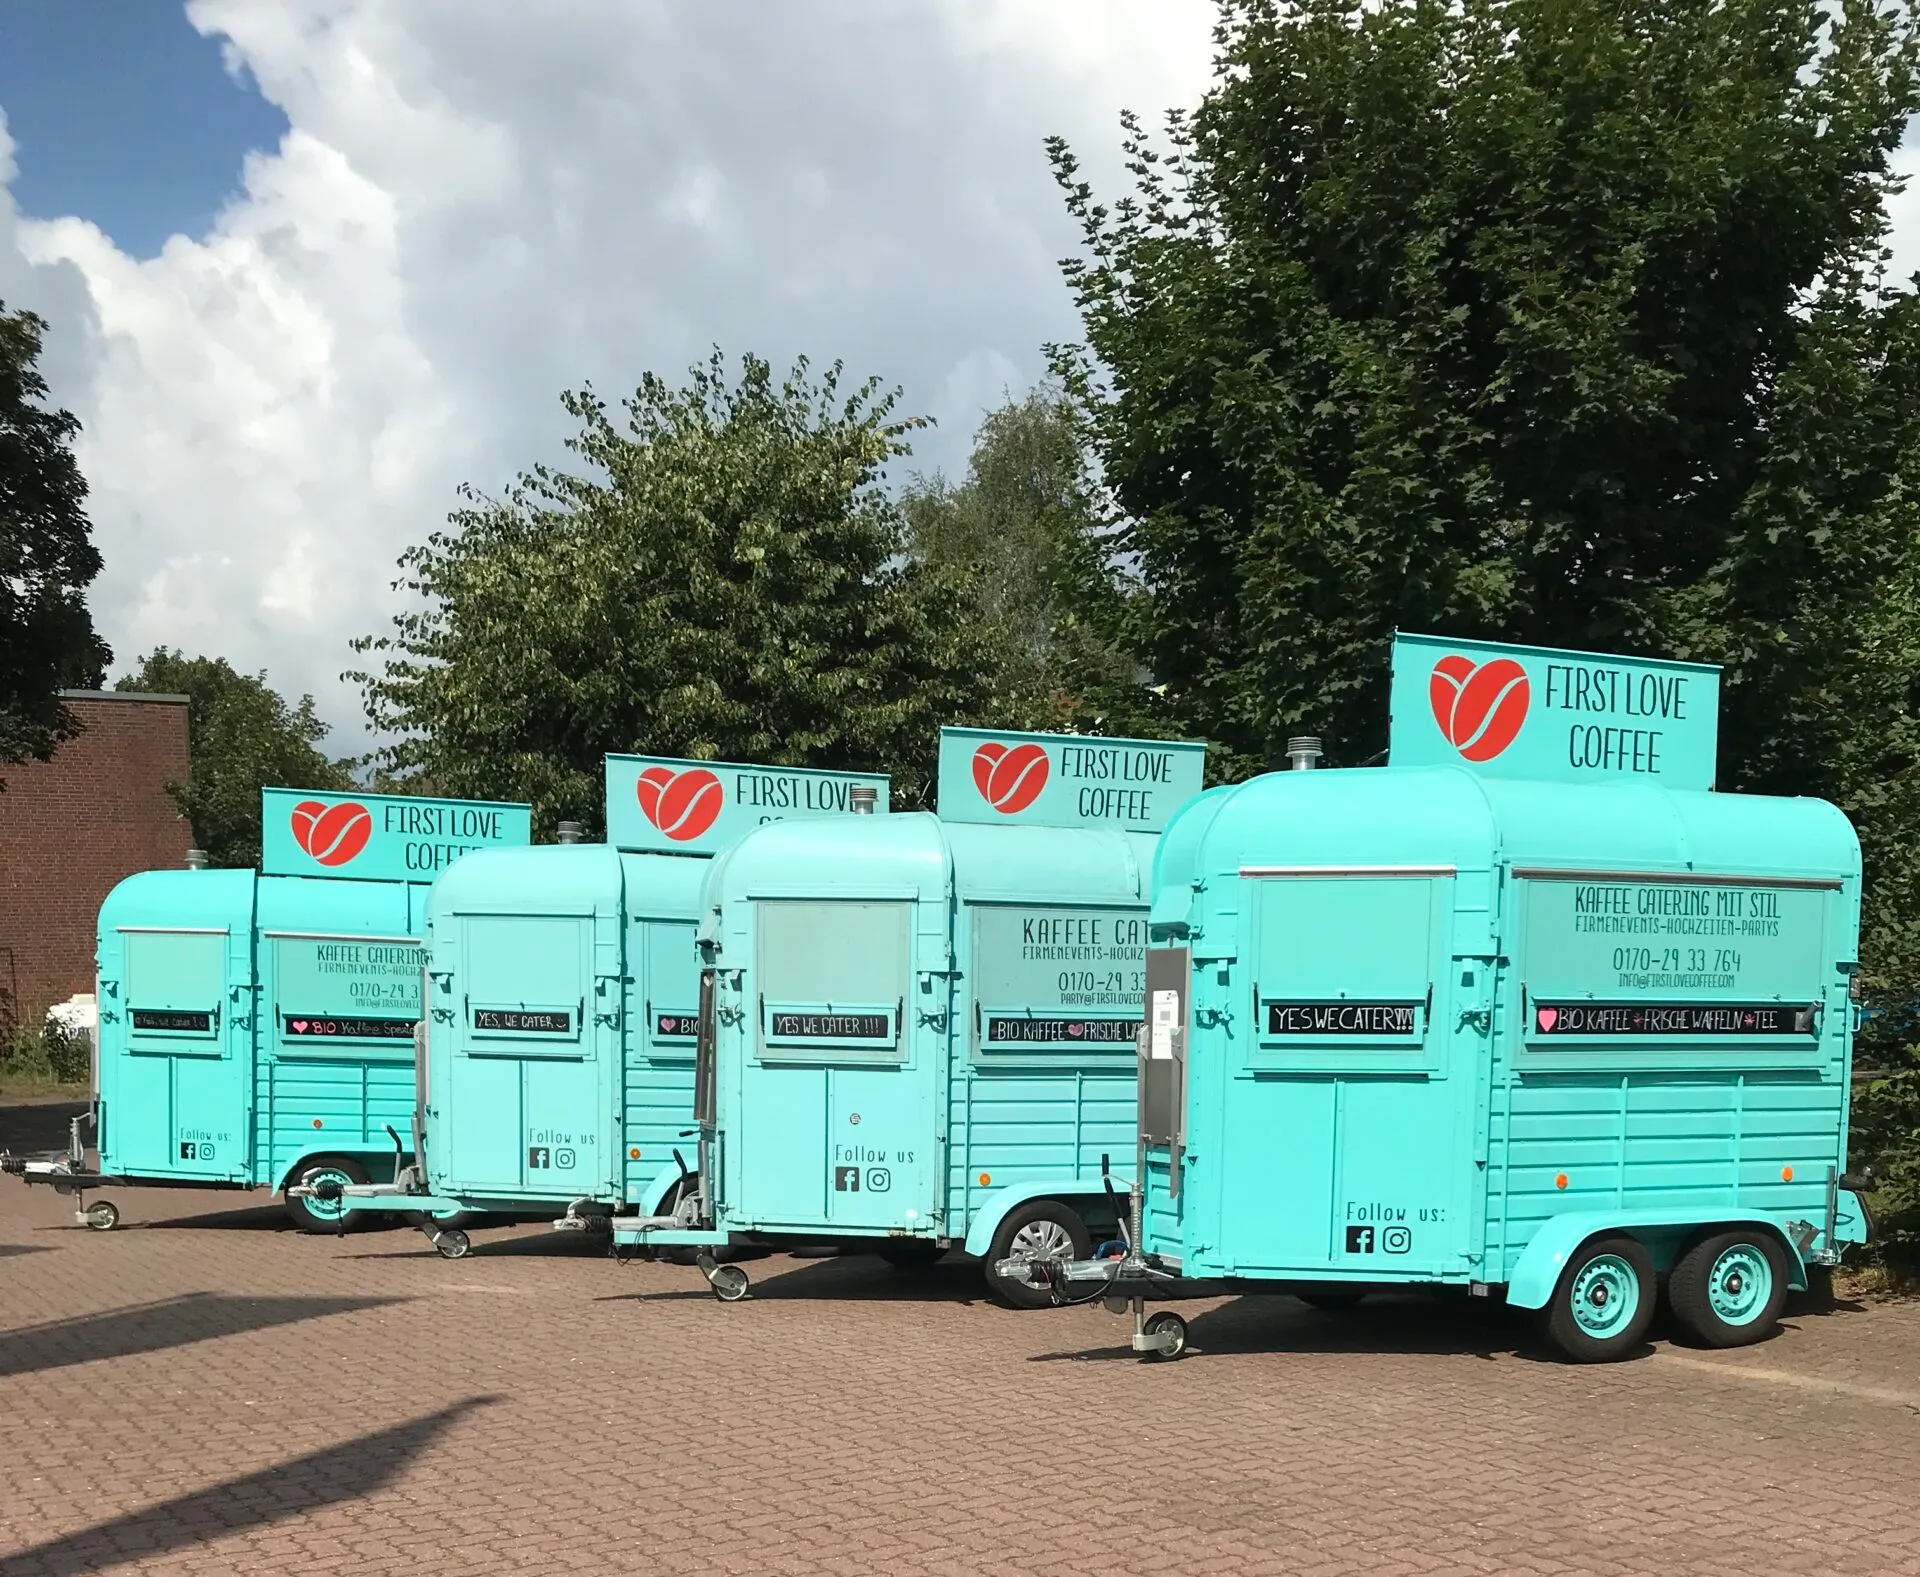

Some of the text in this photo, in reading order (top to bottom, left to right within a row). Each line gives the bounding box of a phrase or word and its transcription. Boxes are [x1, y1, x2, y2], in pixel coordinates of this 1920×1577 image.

[1546, 664, 1688, 719] FIRST LOVE
[1570, 724, 1663, 773] COFFEE
[1061, 747, 1175, 783] FIRST LOVE
[737, 774, 799, 808] FIRST
[1079, 787, 1153, 820] COFFEE
[385, 805, 504, 839] FIRST LOVE
[405, 842, 483, 871] COFF
[1575, 886, 1782, 918] KAFFEE CATERING MIT STIL
[1023, 918, 1102, 945] KAFFEE
[1575, 915, 1779, 937] FIRMENEVENTS-HOCHZEITEN-PARTYS
[317, 945, 362, 962] KAFFEE
[1613, 947, 1741, 972] 0170-29 33 764
[350, 983, 404, 998] 0170-29
[1058, 971, 1122, 991] 0170-29
[1060, 992, 1146, 1006] PARTY@FIRSTLOVECO
[312, 1022, 336, 1034] BIO
[504, 1014, 518, 1028] WE
[521, 1015, 554, 1029] CATER
[776, 1016, 799, 1034] YES
[803, 1017, 818, 1034] WE
[821, 1016, 860, 1034] CATER
[1587, 1009, 1631, 1030] KAFFEE
[1644, 1008, 1689, 1030] FRISCHE
[1692, 1010, 1743, 1030] WAFFELN
[1754, 1010, 1778, 1029] TEE
[998, 1021, 1019, 1040] BIO
[1024, 1021, 1065, 1040] KAFFEE
[1083, 1021, 1123, 1040] FRISCHE
[181, 1127, 212, 1141] Follow
[529, 1128, 595, 1145] Follow us
[836, 1144, 914, 1163] Follow us
[1347, 1202, 1445, 1222] Follow us:
